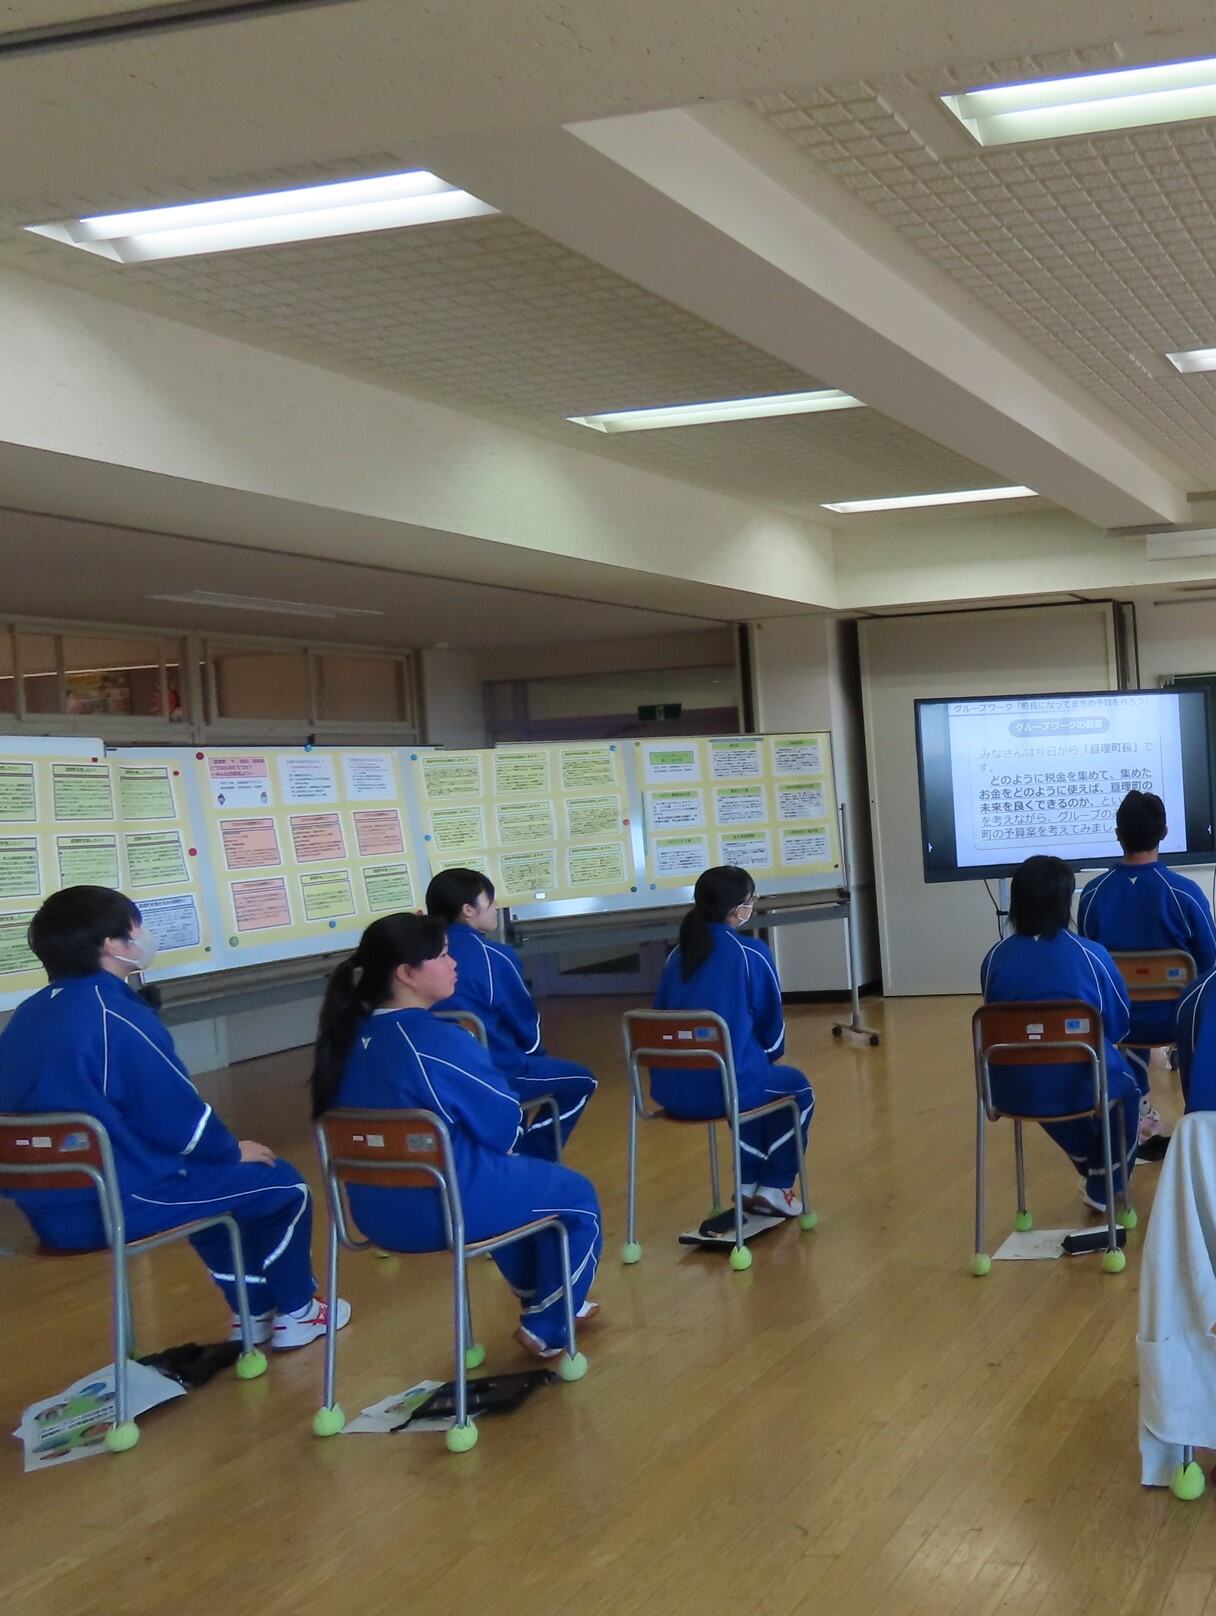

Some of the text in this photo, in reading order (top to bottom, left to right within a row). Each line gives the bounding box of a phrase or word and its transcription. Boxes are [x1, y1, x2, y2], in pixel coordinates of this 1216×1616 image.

[990, 767, 1152, 786] どのように税金を集めて、集めた
